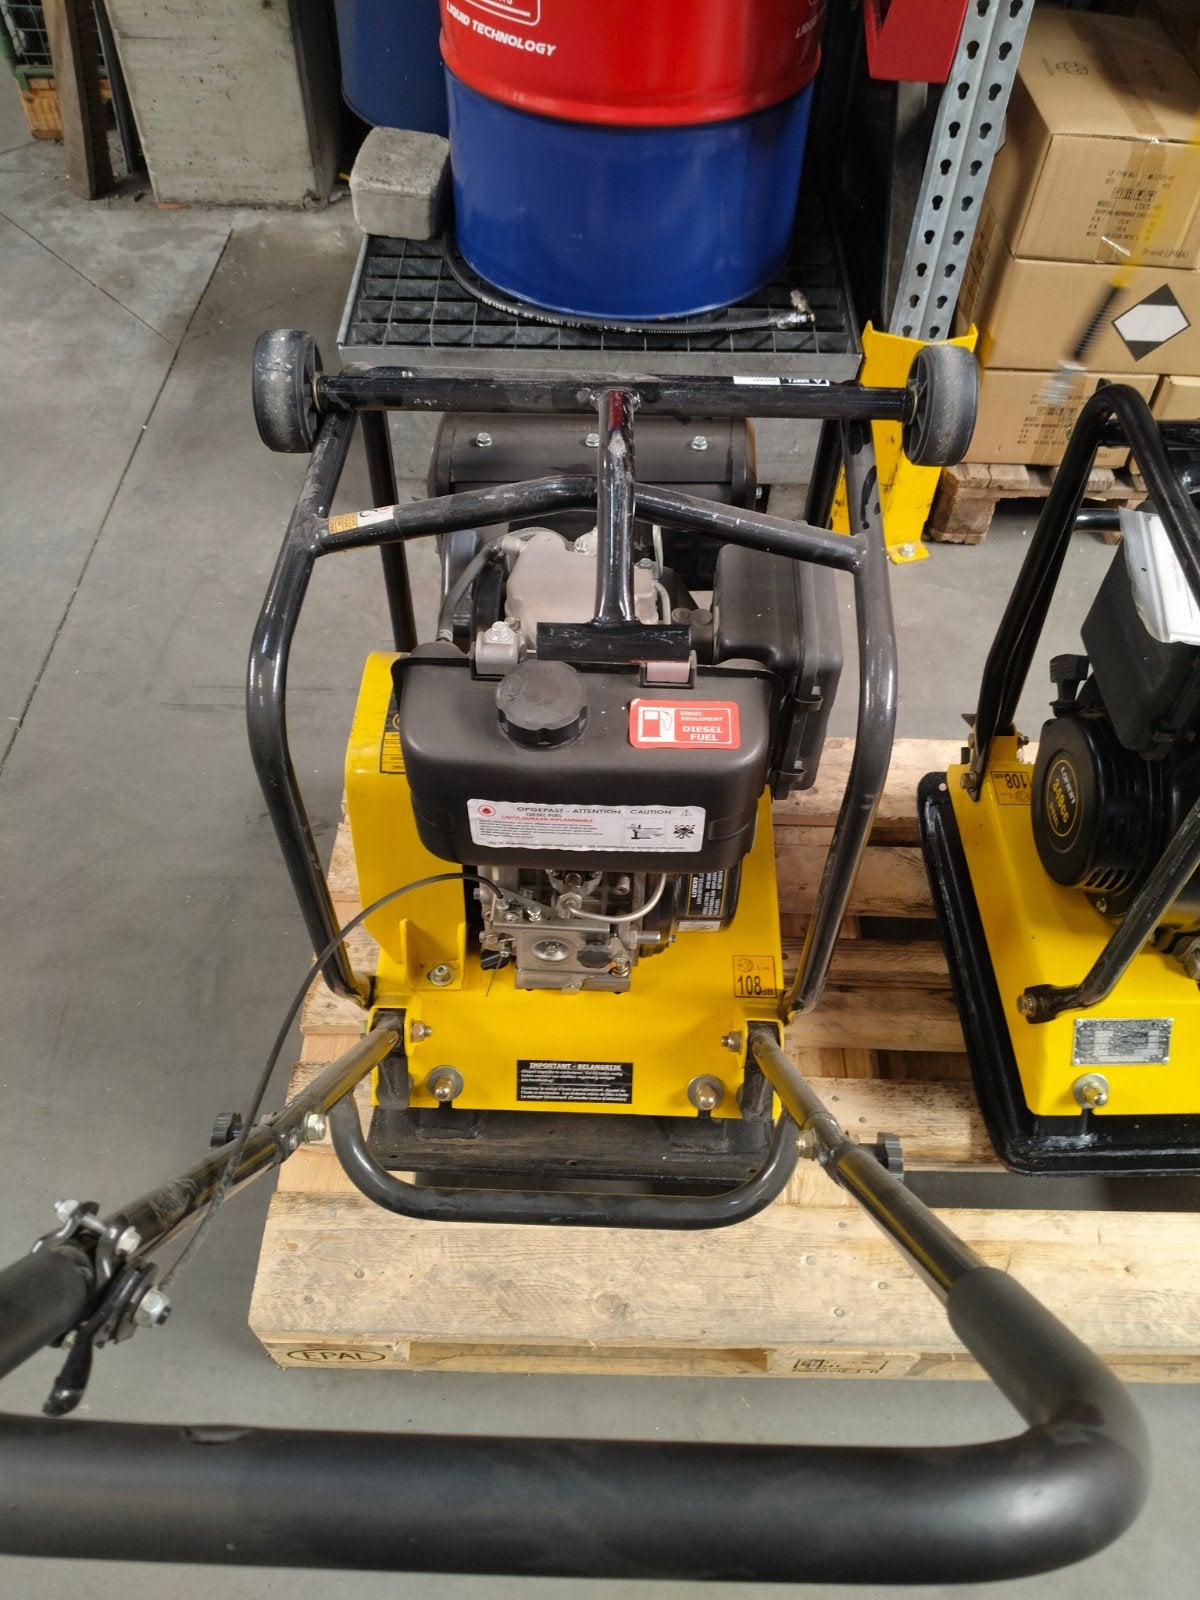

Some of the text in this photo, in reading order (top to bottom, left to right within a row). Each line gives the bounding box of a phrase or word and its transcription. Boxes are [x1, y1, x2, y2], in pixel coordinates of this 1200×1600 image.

[446, 0, 557, 56] LIQUID TECHNOLOGY
[682, 726, 724, 734] DIESEL
[690, 733, 719, 741] FUEL
[529, 1062, 622, 1071] IMPORTANT BELANGRIJK
[302, 1351, 370, 1360] EPAL
